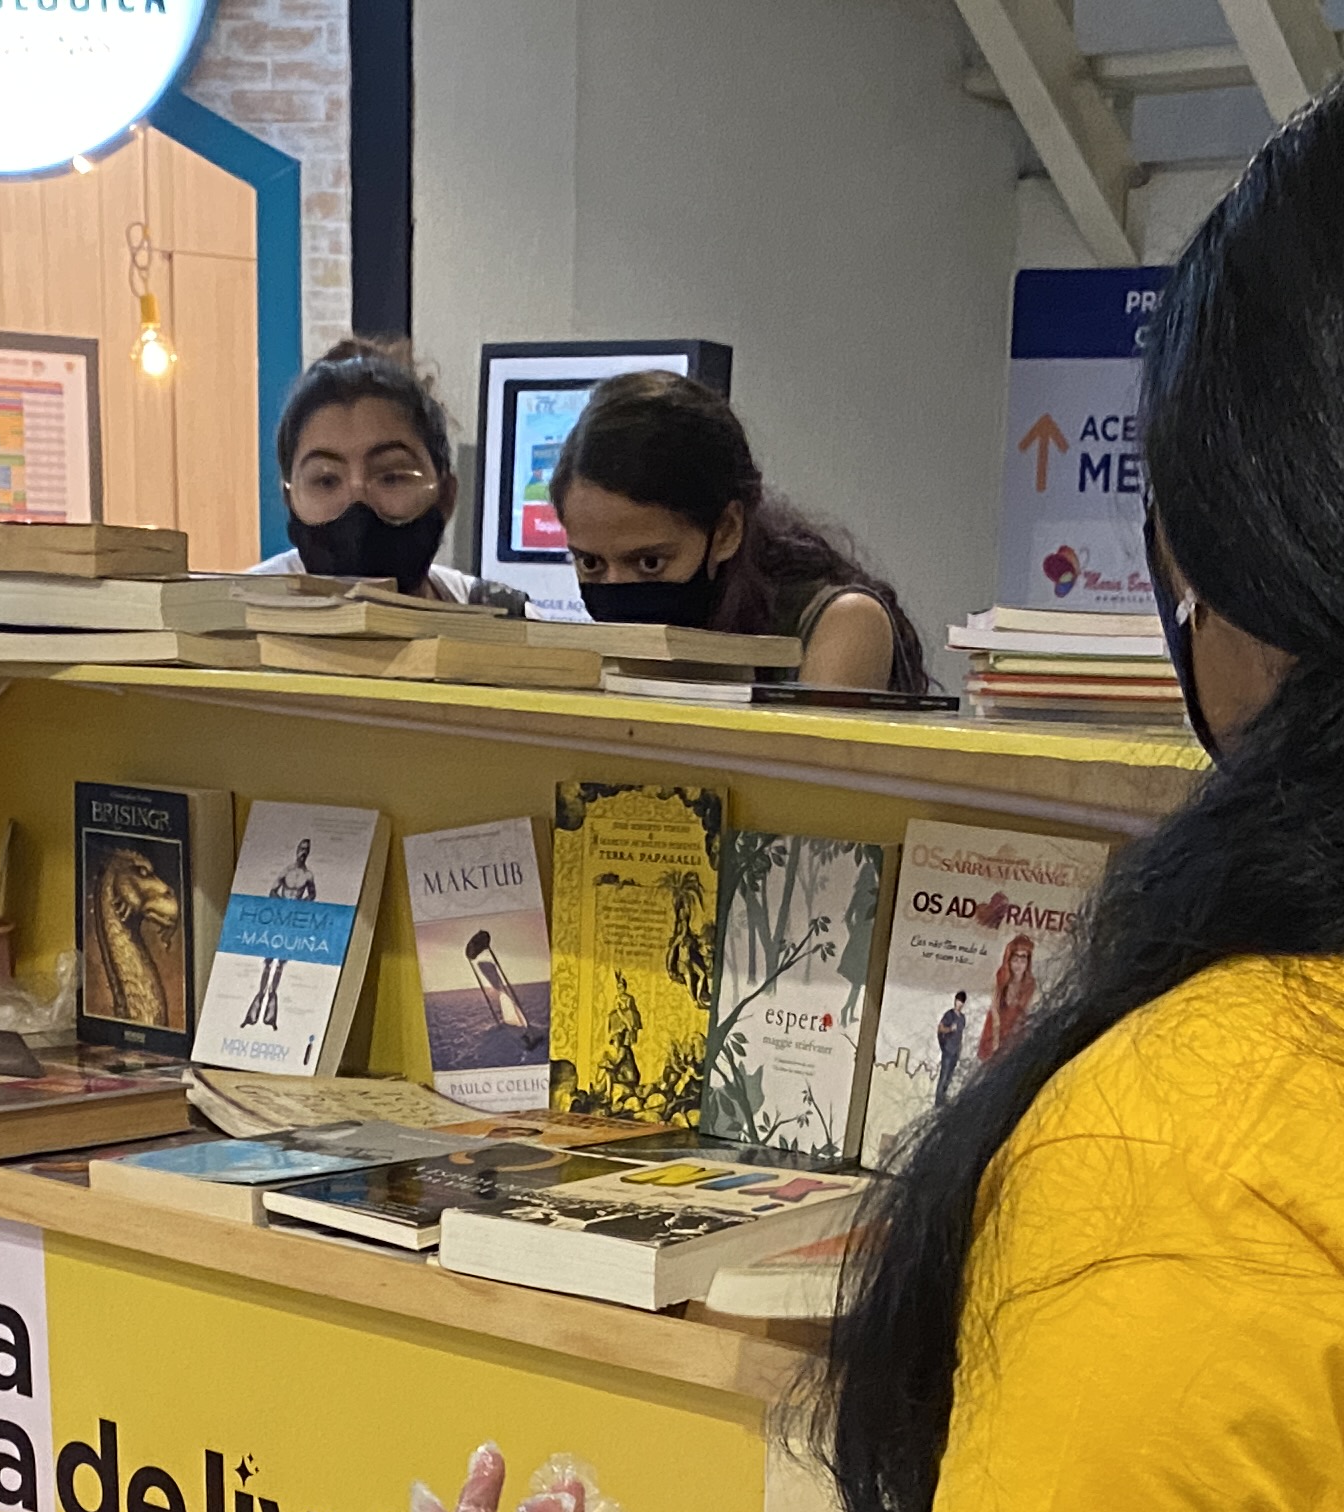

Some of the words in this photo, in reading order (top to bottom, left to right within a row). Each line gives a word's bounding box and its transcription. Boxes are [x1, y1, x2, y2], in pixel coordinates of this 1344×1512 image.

[90, 800, 170, 831] BRISINGR
[422, 860, 524, 896] MAKTUB
[912, 891, 943, 915] OS
[764, 1007, 833, 1035] espera
[450, 1079, 492, 1096] PAULO
